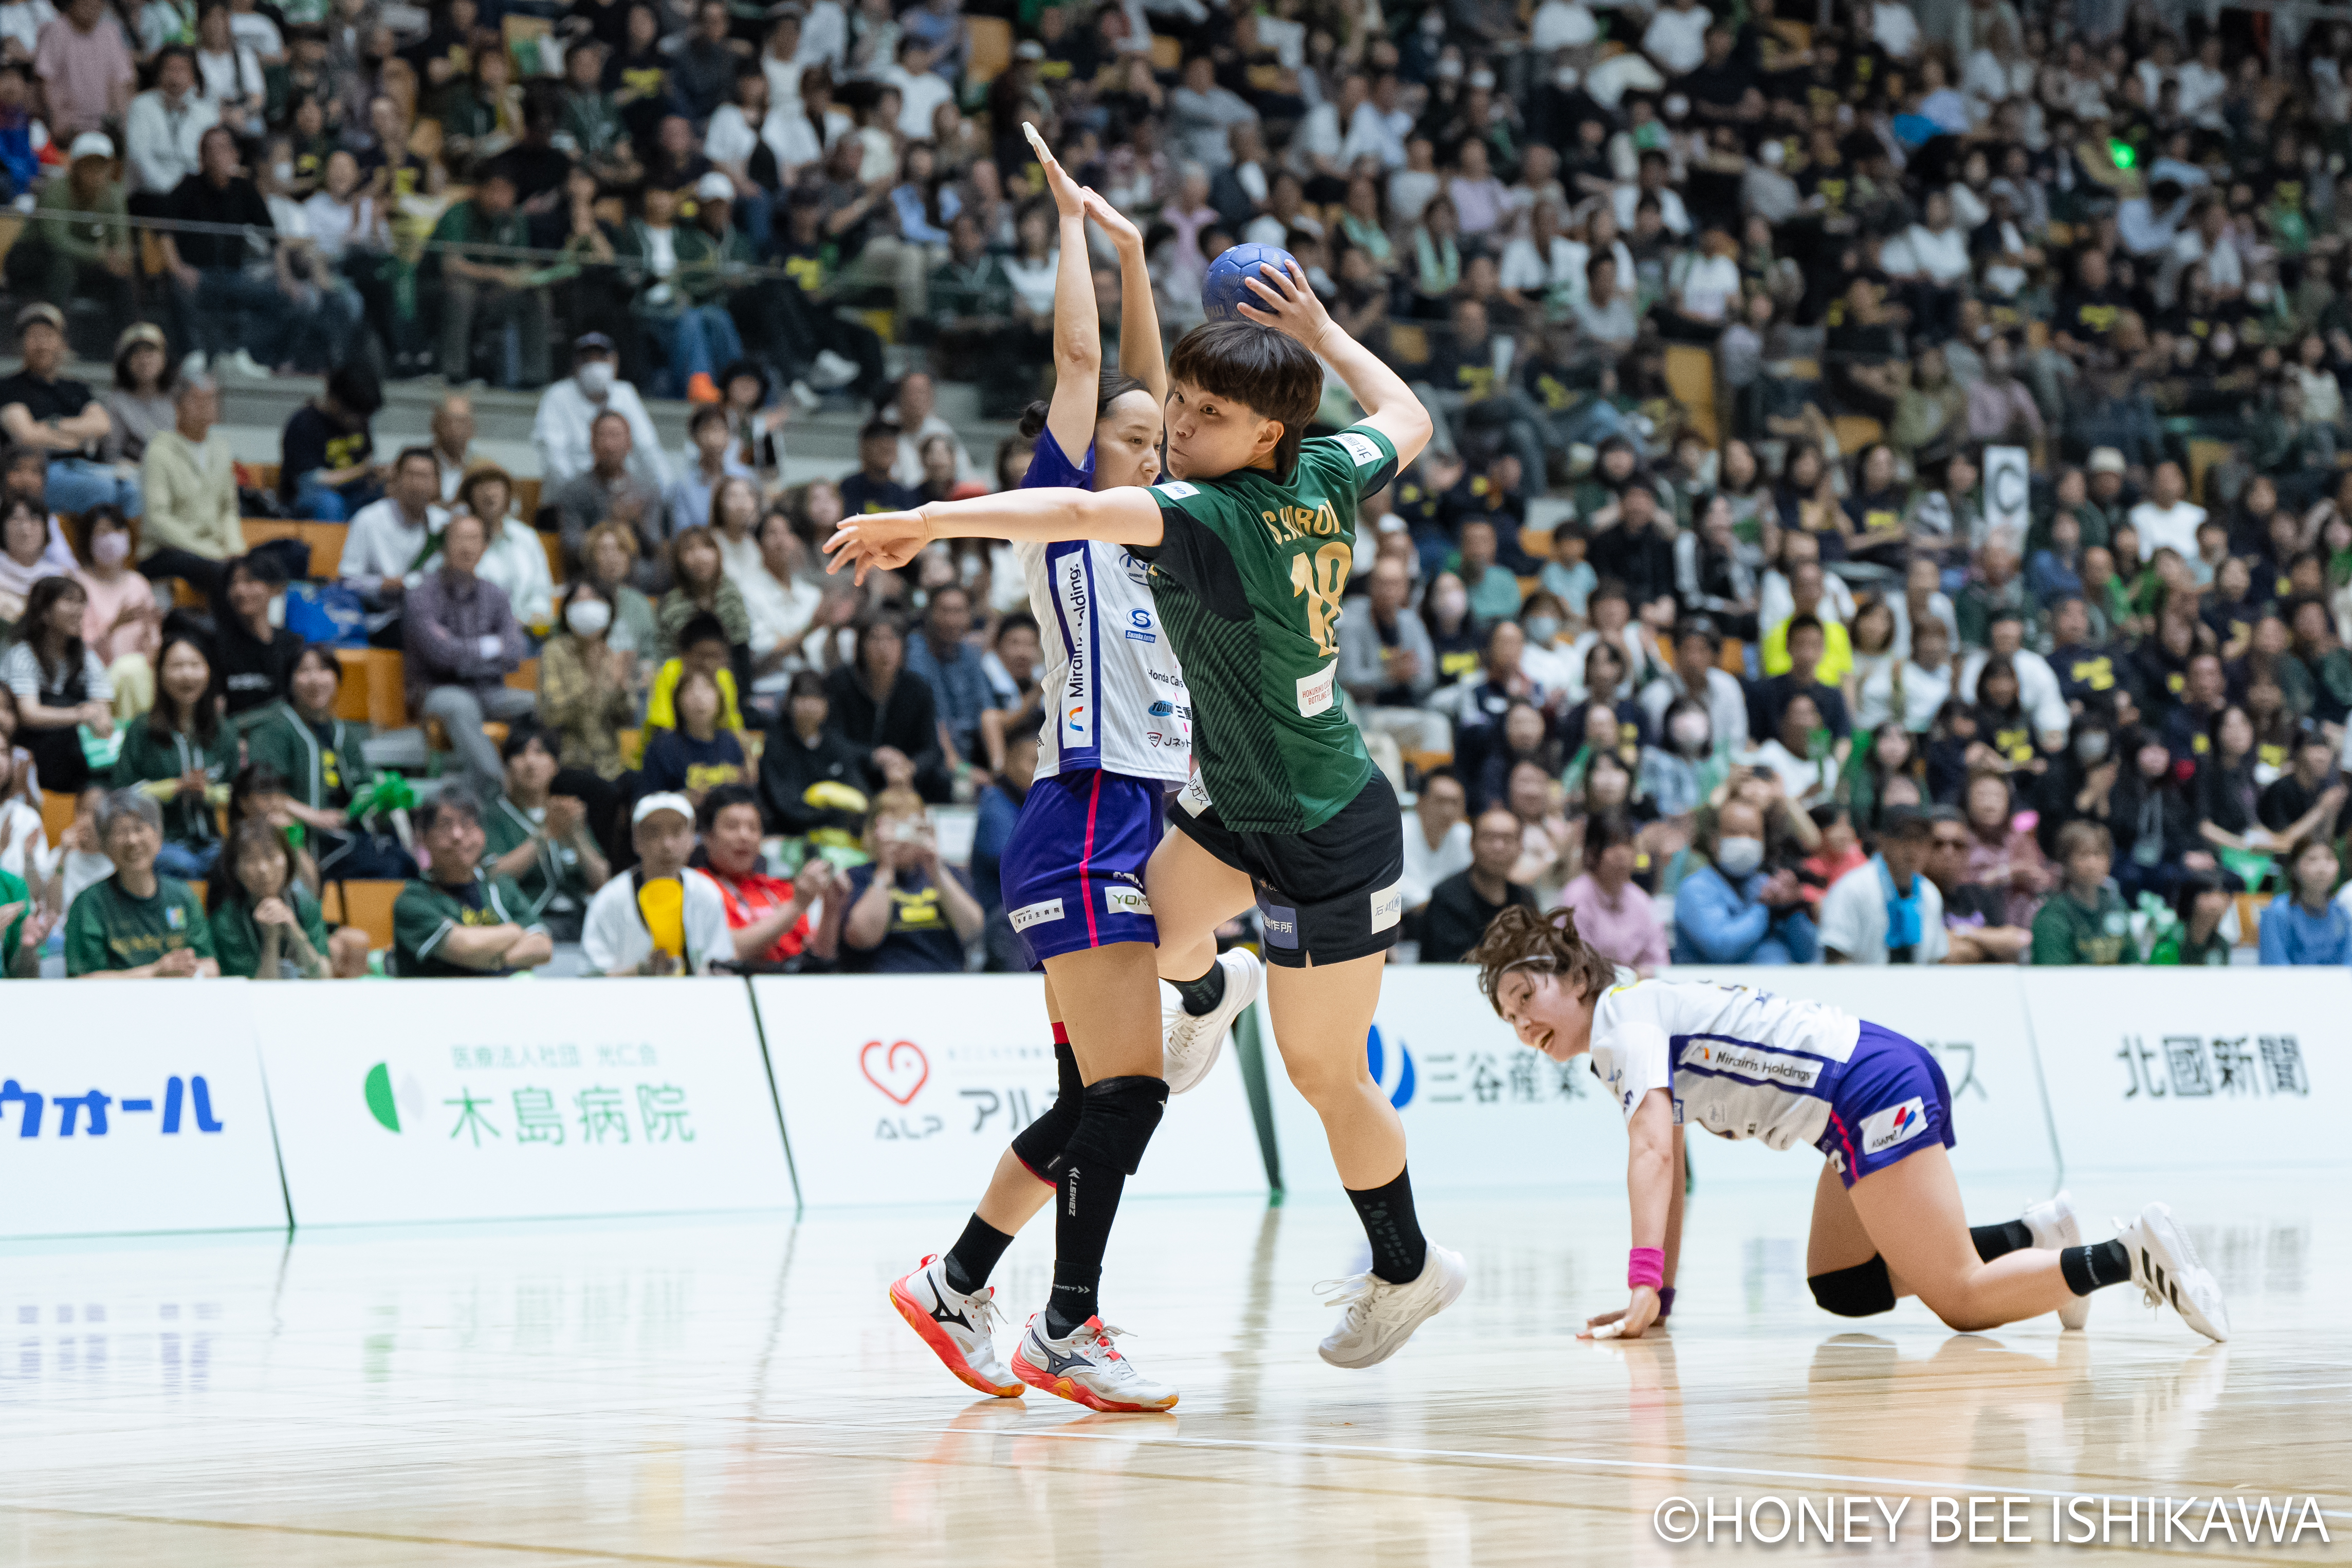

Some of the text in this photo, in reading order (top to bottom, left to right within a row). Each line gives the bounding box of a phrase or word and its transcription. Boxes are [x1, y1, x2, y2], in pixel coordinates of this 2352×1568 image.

[1290, 541, 1352, 658] 18
[1147, 668, 1169, 684] Honda
[1302, 684, 1324, 698] HOKURIKU
[1308, 691, 1327, 705] BOTTLING
[1164, 737, 1191, 747] Jネット
[1761, 1061, 1811, 1082] Holdings
[2116, 1035, 2309, 1098] 北國新聞
[443, 1083, 696, 1148] 木島病院
[957, 1086, 1059, 1136] アル
